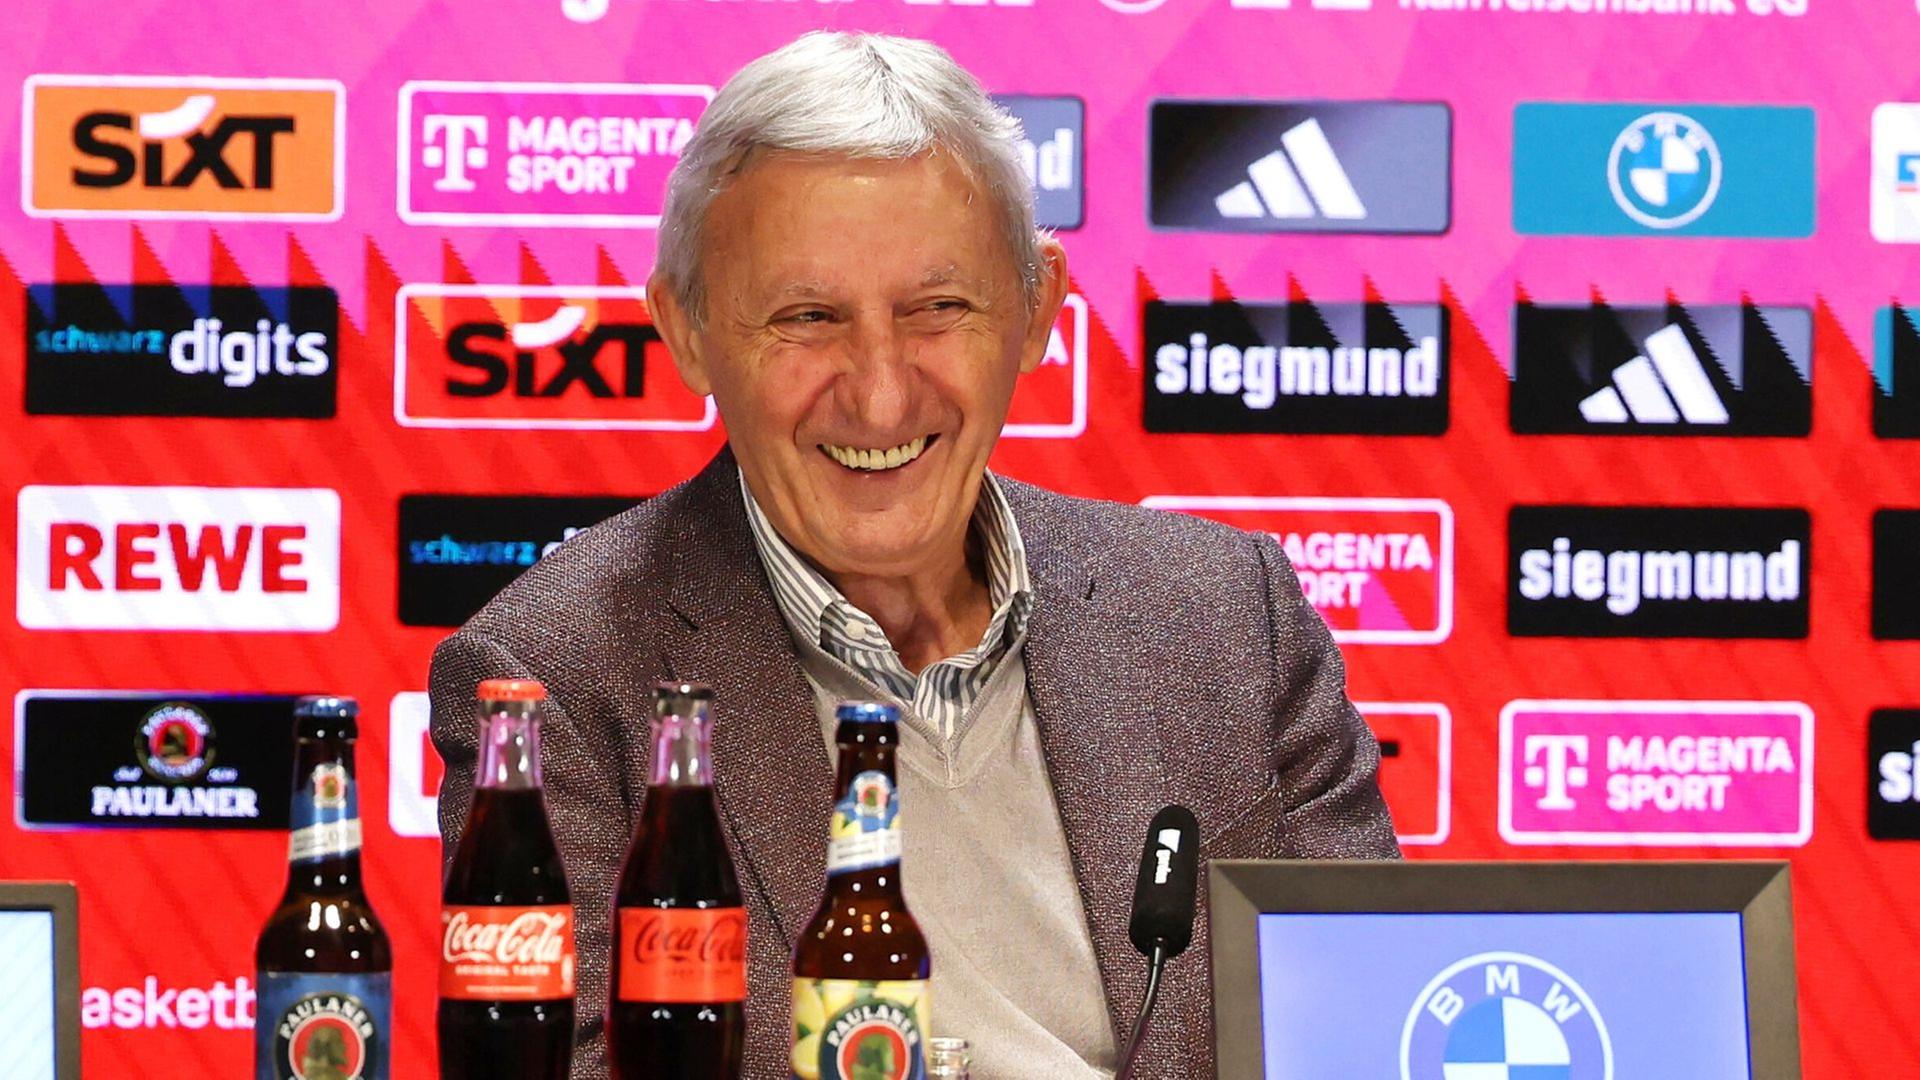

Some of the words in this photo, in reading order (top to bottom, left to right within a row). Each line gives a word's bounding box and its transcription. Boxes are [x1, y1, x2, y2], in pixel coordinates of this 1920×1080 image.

[507, 116, 698, 155] MAGENTA
[506, 155, 635, 194] SPORT
[36, 325, 165, 354] schwarz
[169, 317, 330, 387] digits
[1155, 334, 1439, 409] siegmund
[48, 522, 308, 594] REWE
[1271, 532, 1433, 571] AGENTA
[1299, 570, 1369, 608] ORT
[1518, 537, 1800, 615] siegmund
[1606, 735, 1795, 775] MAGENTA
[91, 786, 260, 817] PAULANER
[1606, 774, 1731, 811] SPORT
[1427, 964, 1583, 1027] BMW
[279, 996, 374, 1040] PAULANER
[826, 1004, 919, 1047] PAULANER
